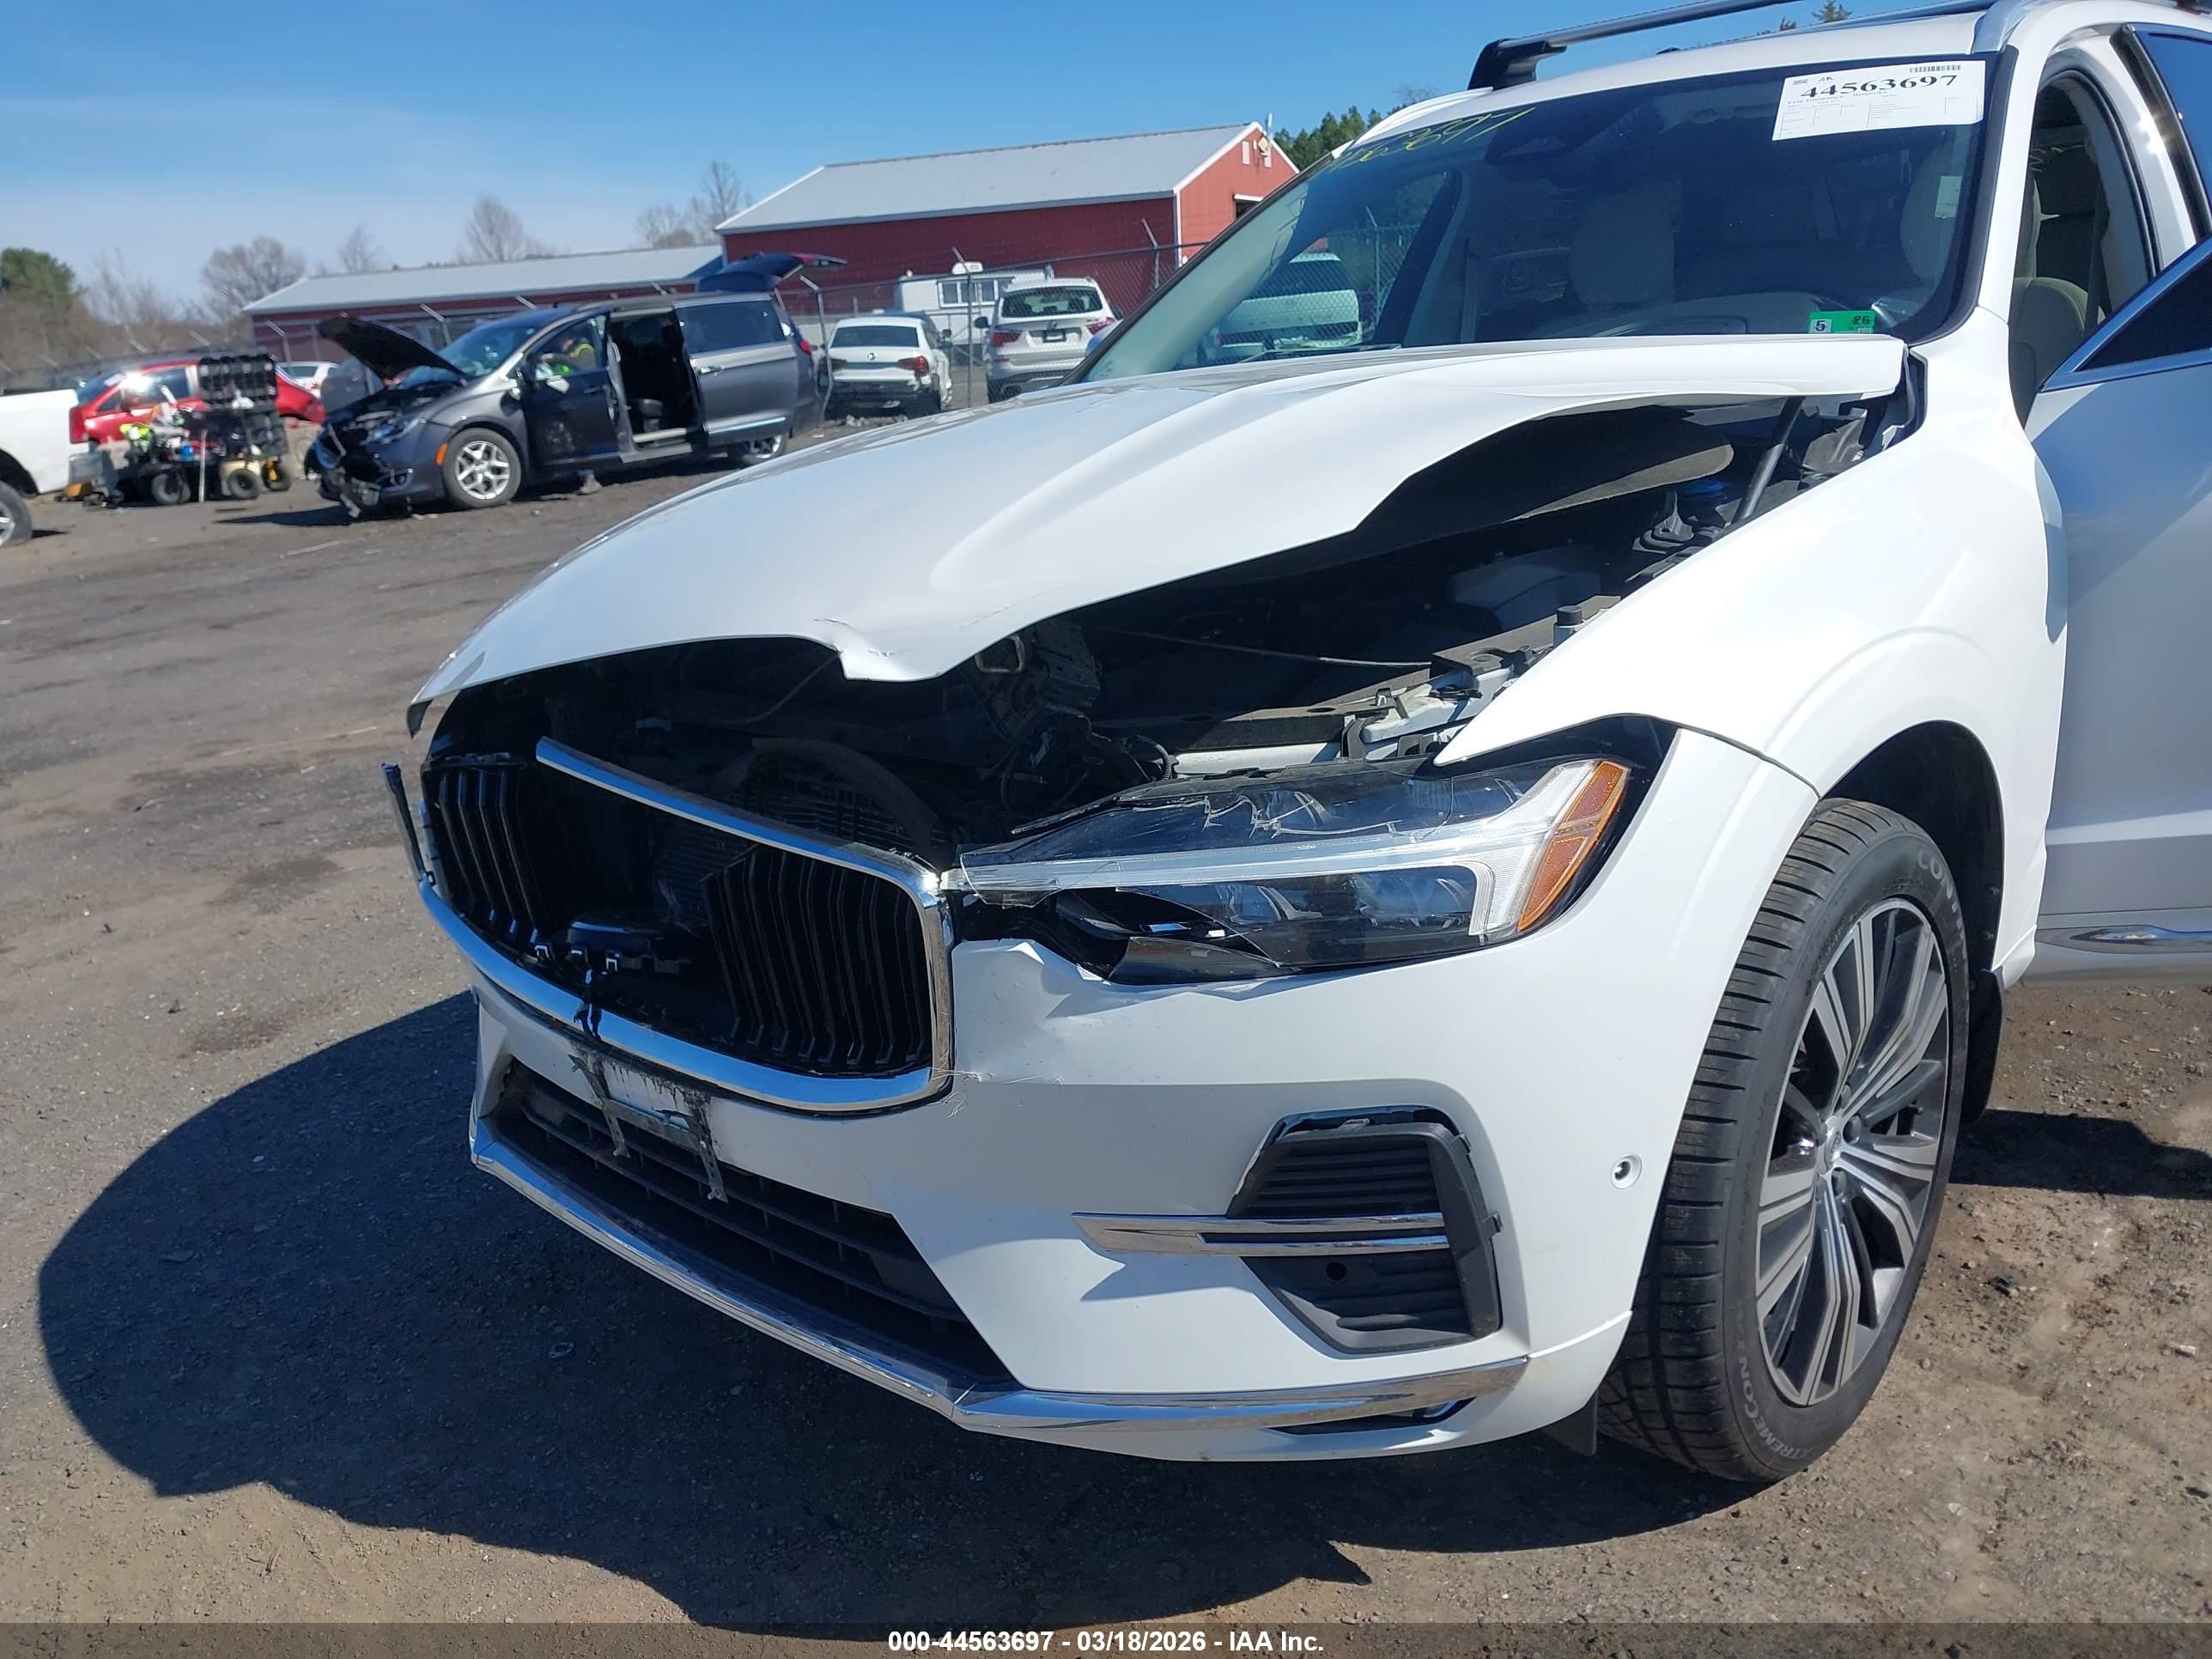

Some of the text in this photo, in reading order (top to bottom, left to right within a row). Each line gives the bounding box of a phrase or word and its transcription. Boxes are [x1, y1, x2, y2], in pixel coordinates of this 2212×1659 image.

[1800, 74, 1958, 98] 44563697
[1815, 319, 1826, 331] 5
[1852, 315, 1870, 325] 26
